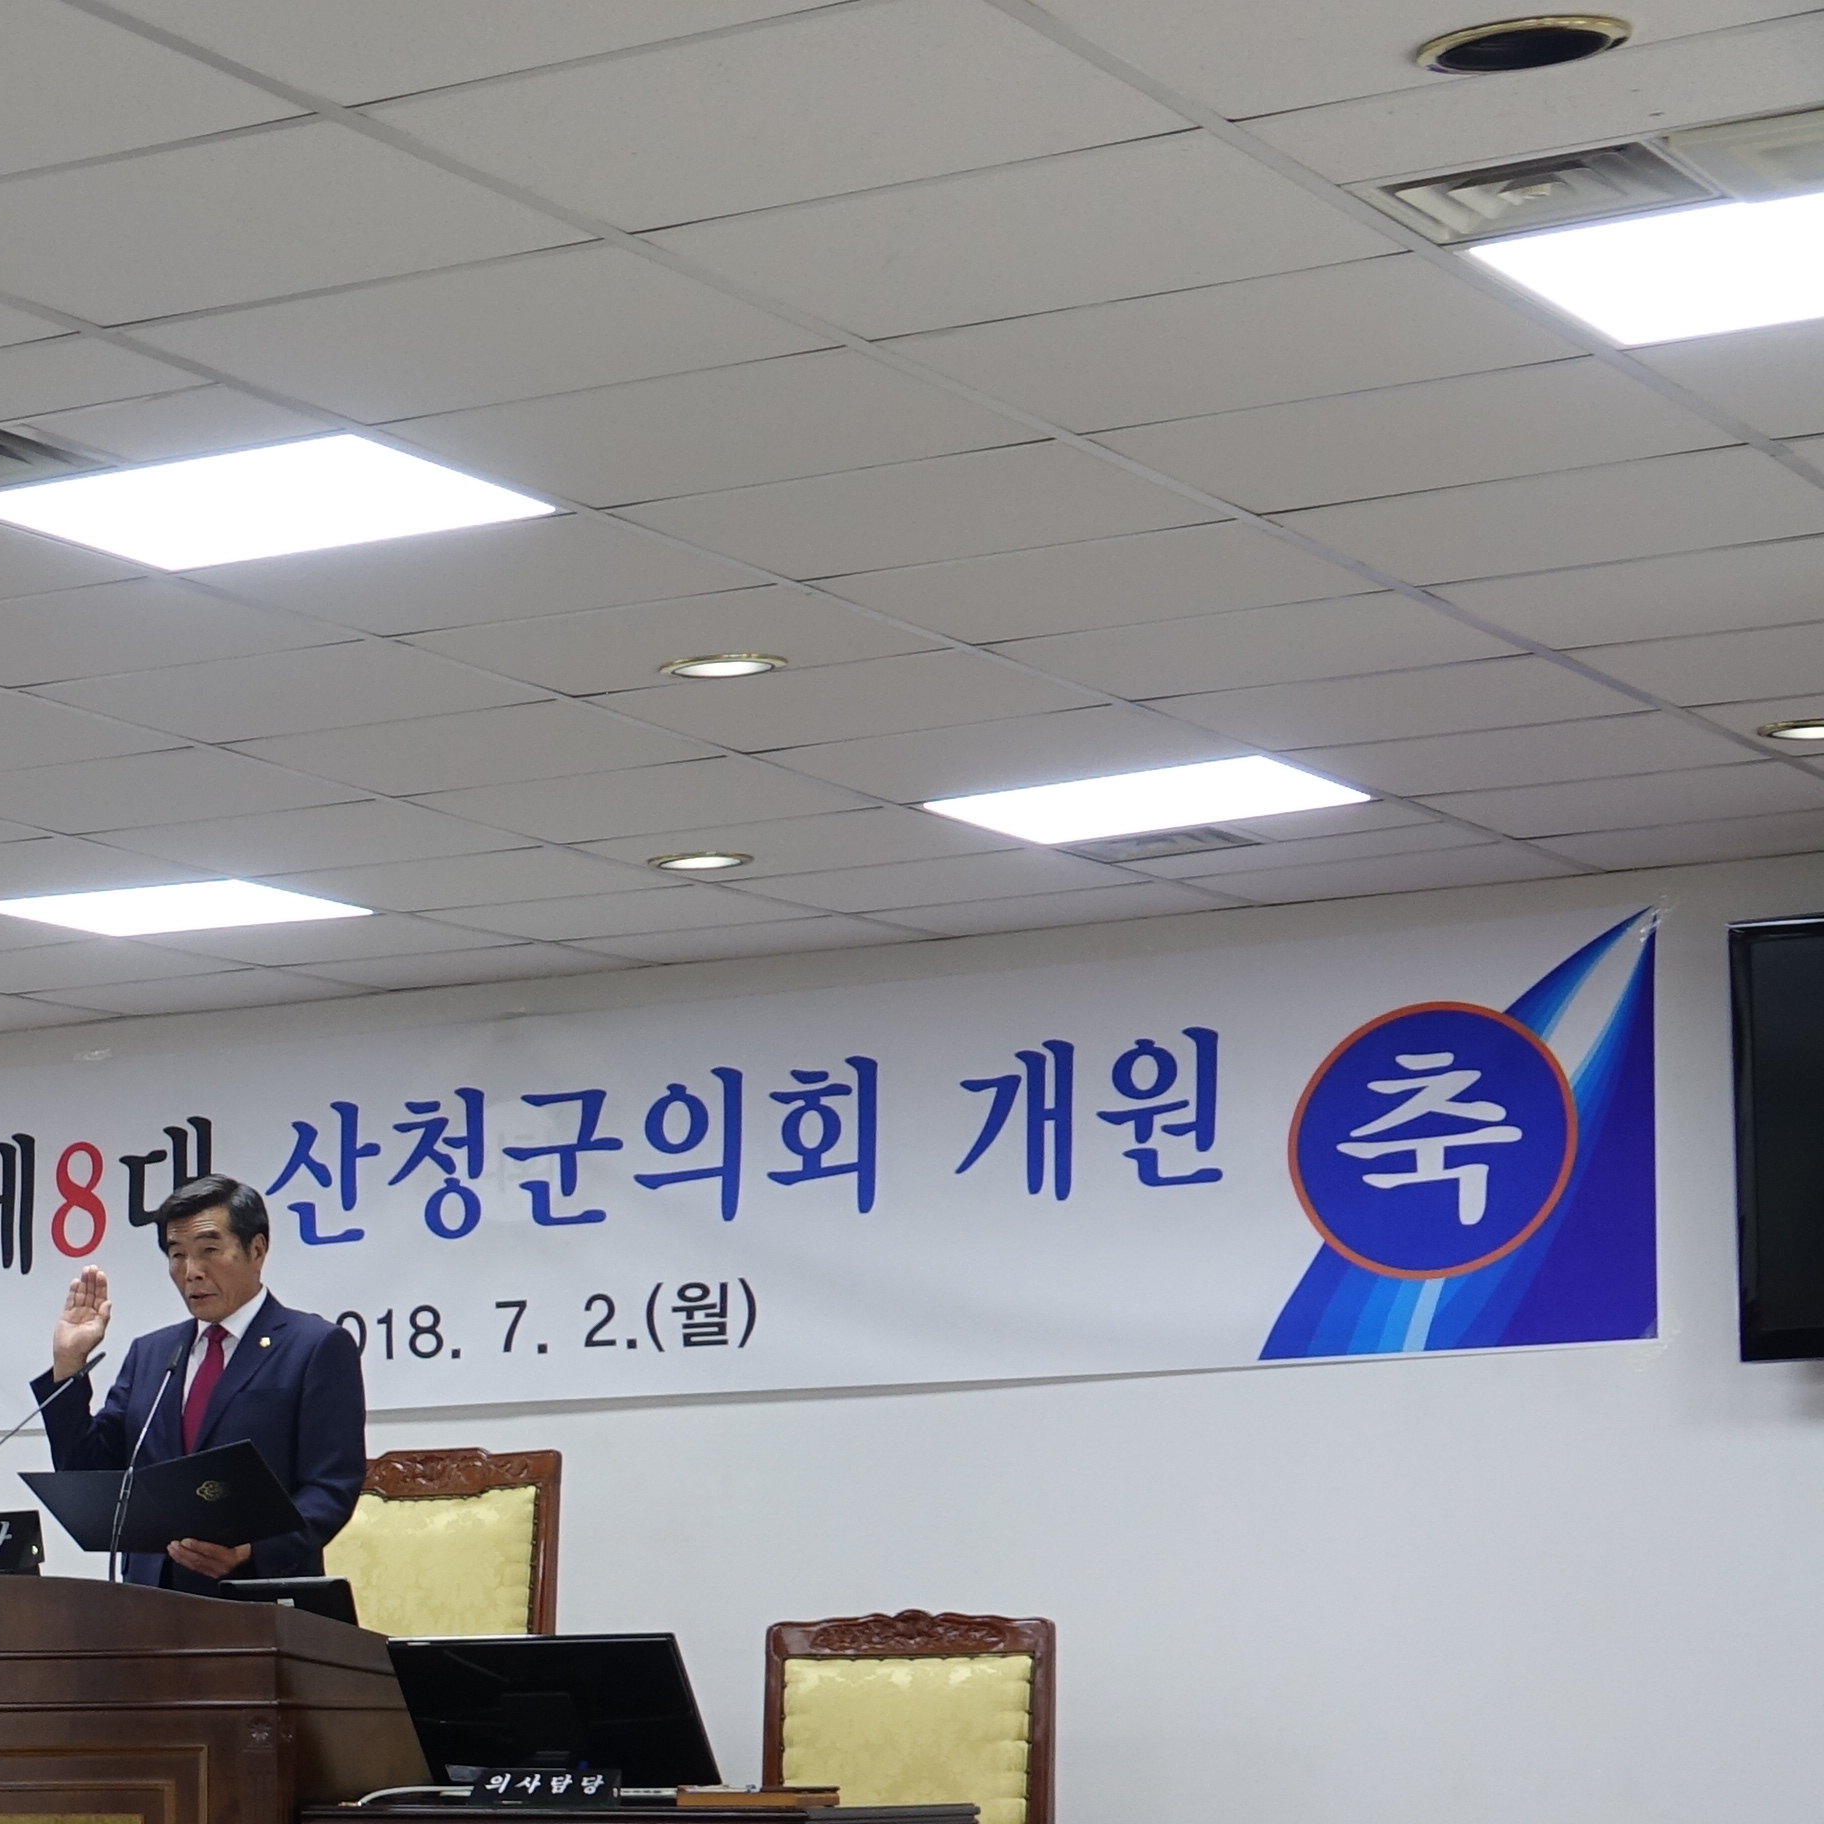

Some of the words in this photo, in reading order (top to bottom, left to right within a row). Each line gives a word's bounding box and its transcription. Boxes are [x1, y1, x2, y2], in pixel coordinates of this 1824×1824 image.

[263, 1054, 880, 1247] 산청군의회
[952, 1025, 1225, 1202] 개원
[1335, 1051, 1523, 1226] 축
[336, 1303, 462, 1361] 018.
[494, 1299, 549, 1355] 7.
[583, 1277, 758, 1353] 2.(월)
[484, 1772, 605, 1795] 의사담당
